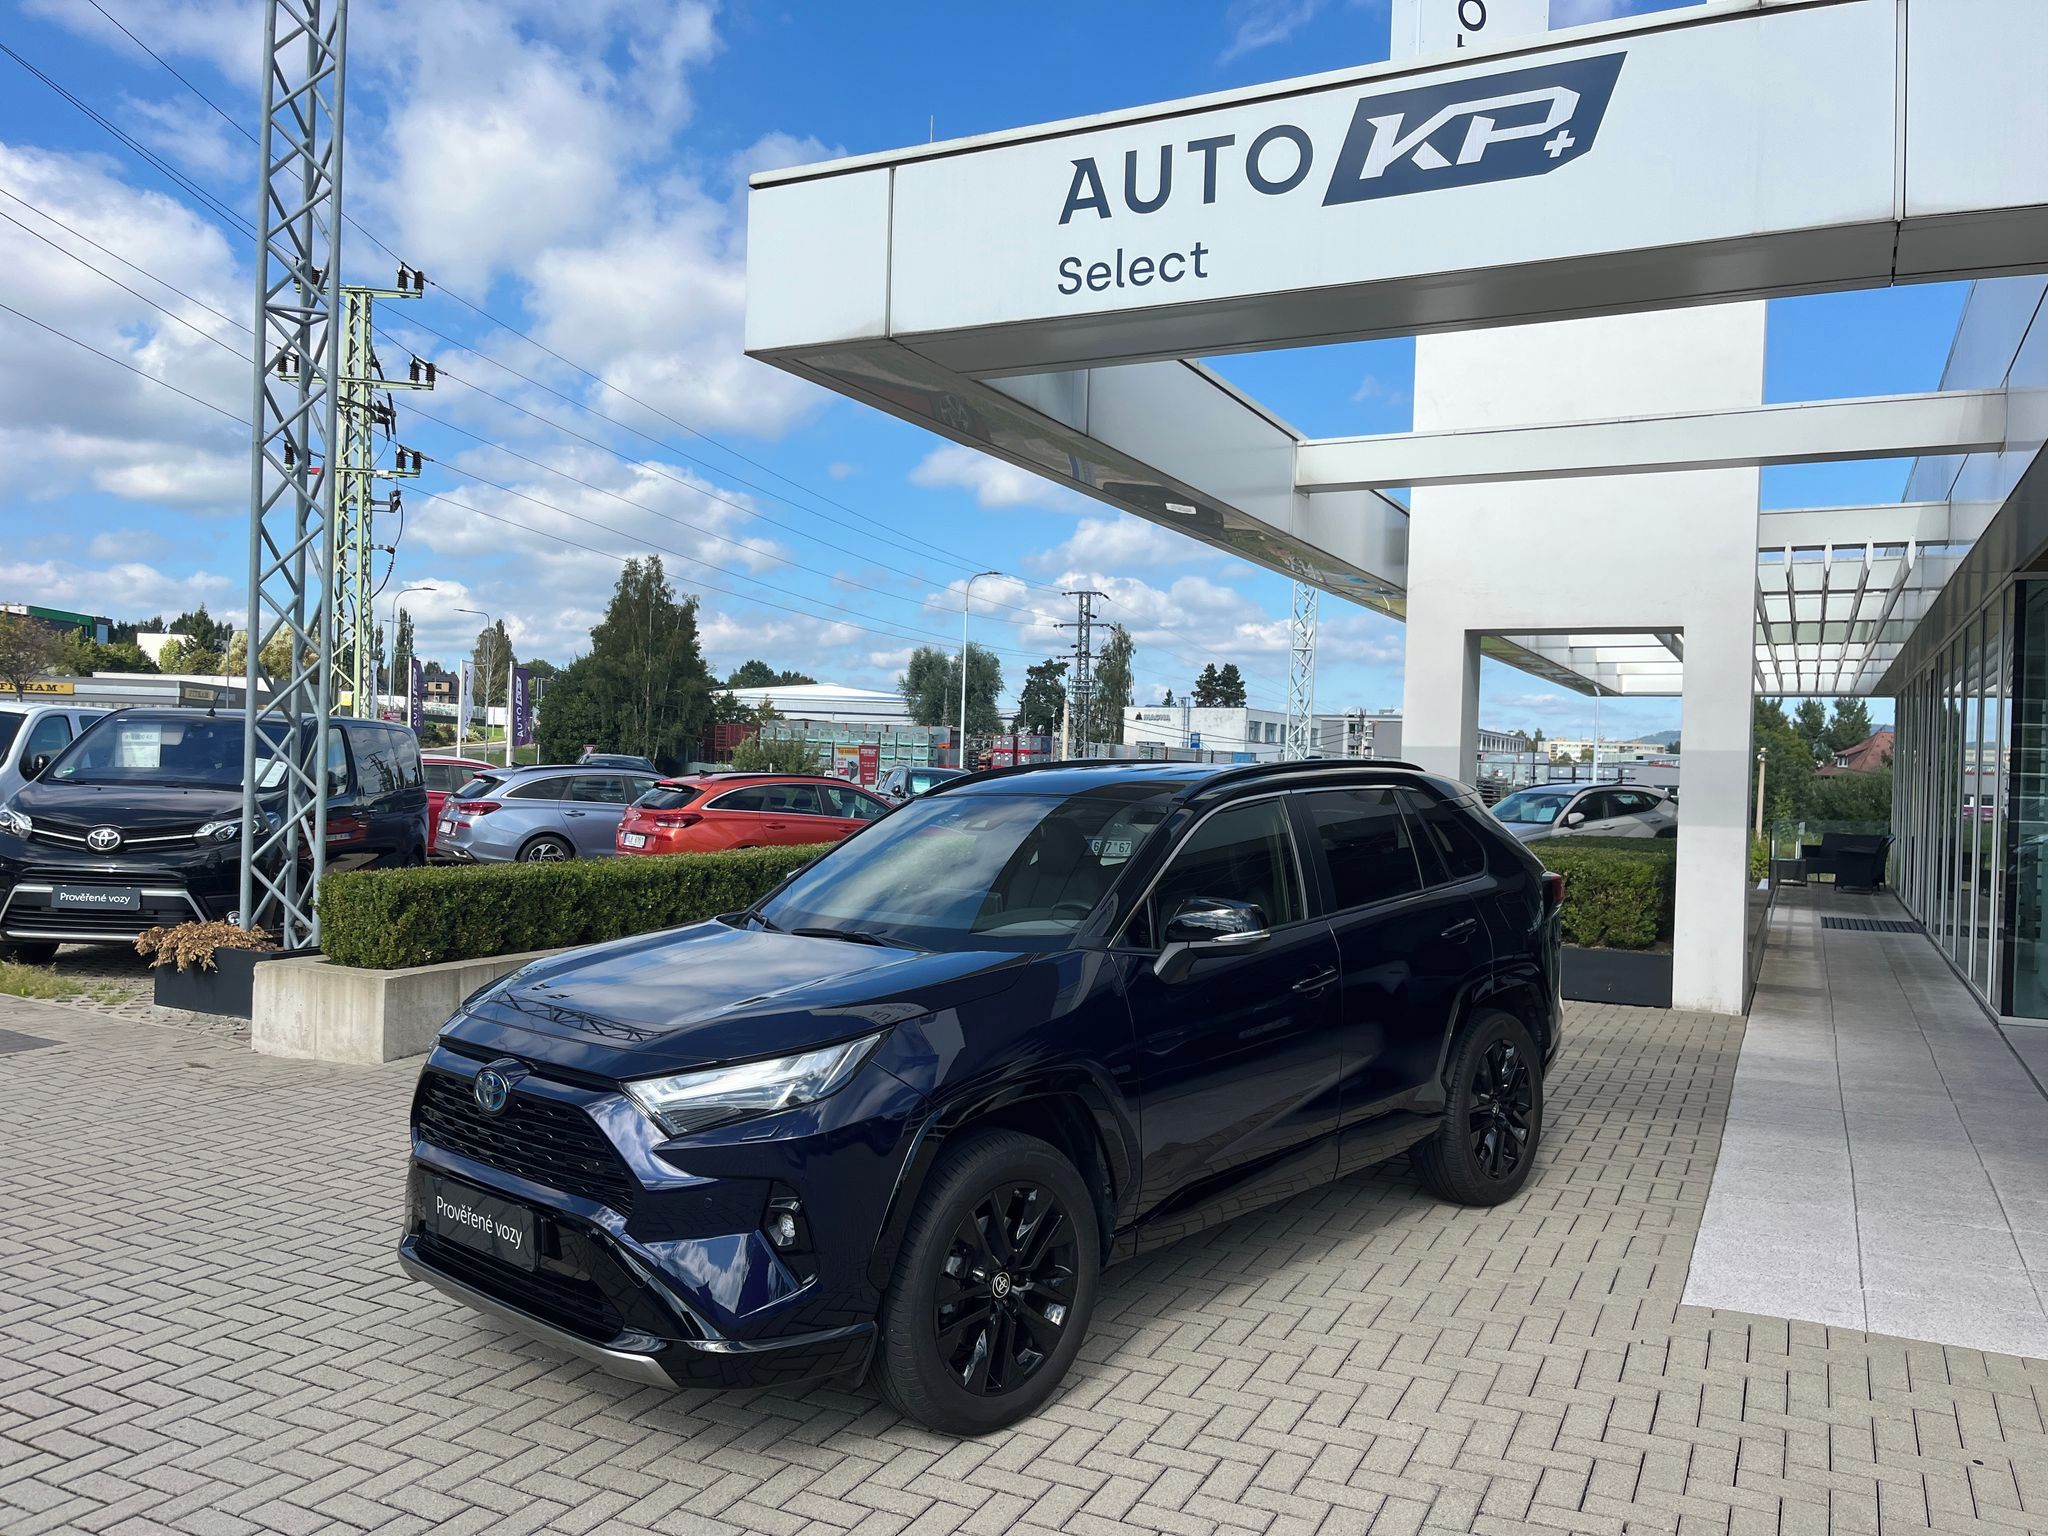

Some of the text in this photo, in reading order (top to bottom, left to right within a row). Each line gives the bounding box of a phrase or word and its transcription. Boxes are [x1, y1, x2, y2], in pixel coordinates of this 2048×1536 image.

[1057, 123, 1314, 225] AUTO
[1057, 241, 1209, 295] Select
[516, 706, 524, 738] AUTO
[1093, 841, 1113, 853] 67
[60, 892, 131, 905] Prověřené vozy
[436, 1195, 523, 1250] Prověřené vozy
